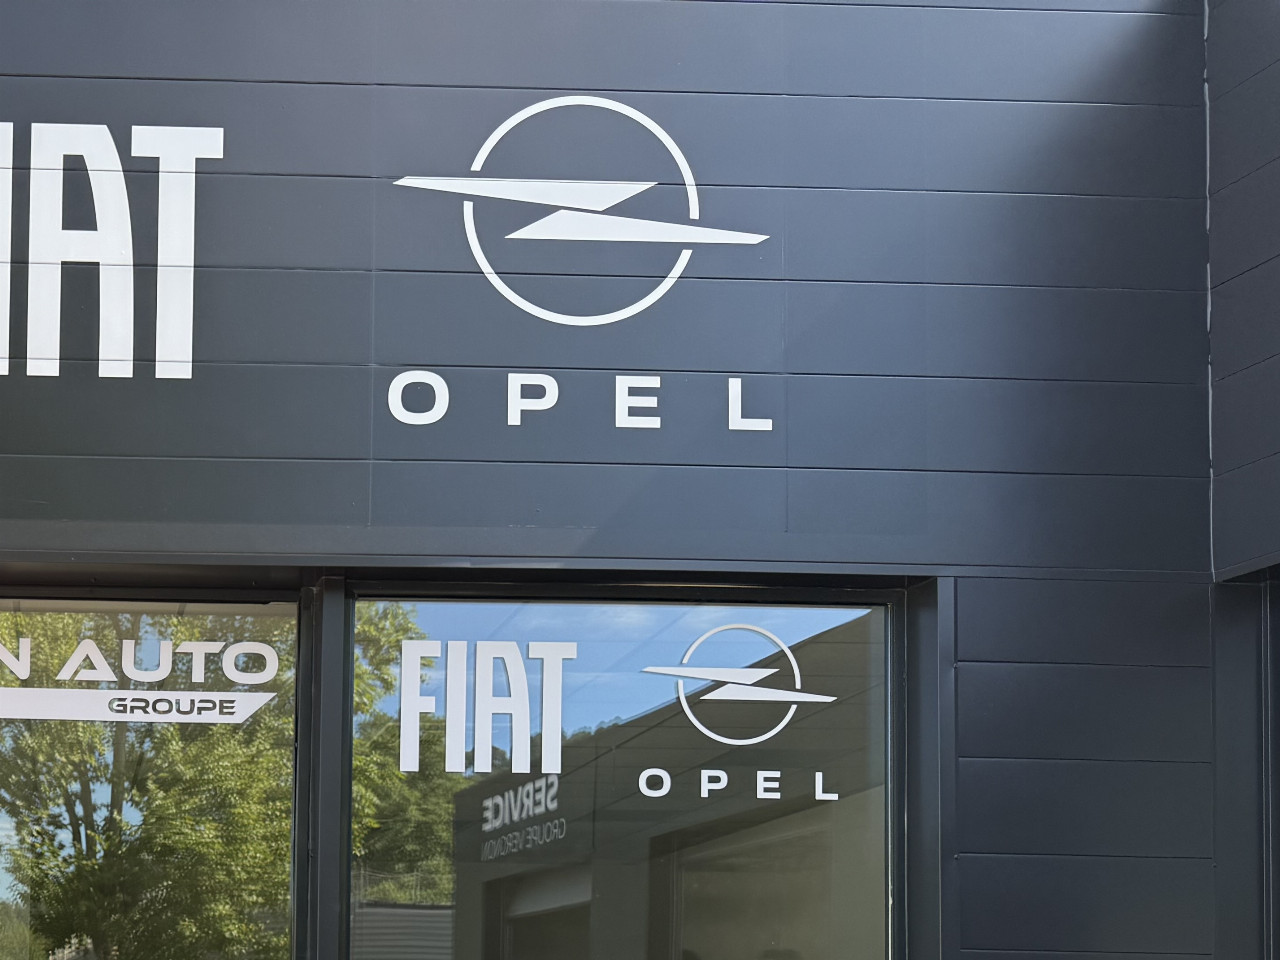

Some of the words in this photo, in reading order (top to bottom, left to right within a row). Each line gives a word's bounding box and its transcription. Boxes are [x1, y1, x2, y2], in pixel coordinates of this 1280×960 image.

[387, 370, 773, 431] OPEL
[55, 638, 279, 685] AUTO
[108, 696, 237, 717] GROUPE
[399, 639, 578, 774] FIAT
[638, 768, 839, 800] OPEL
